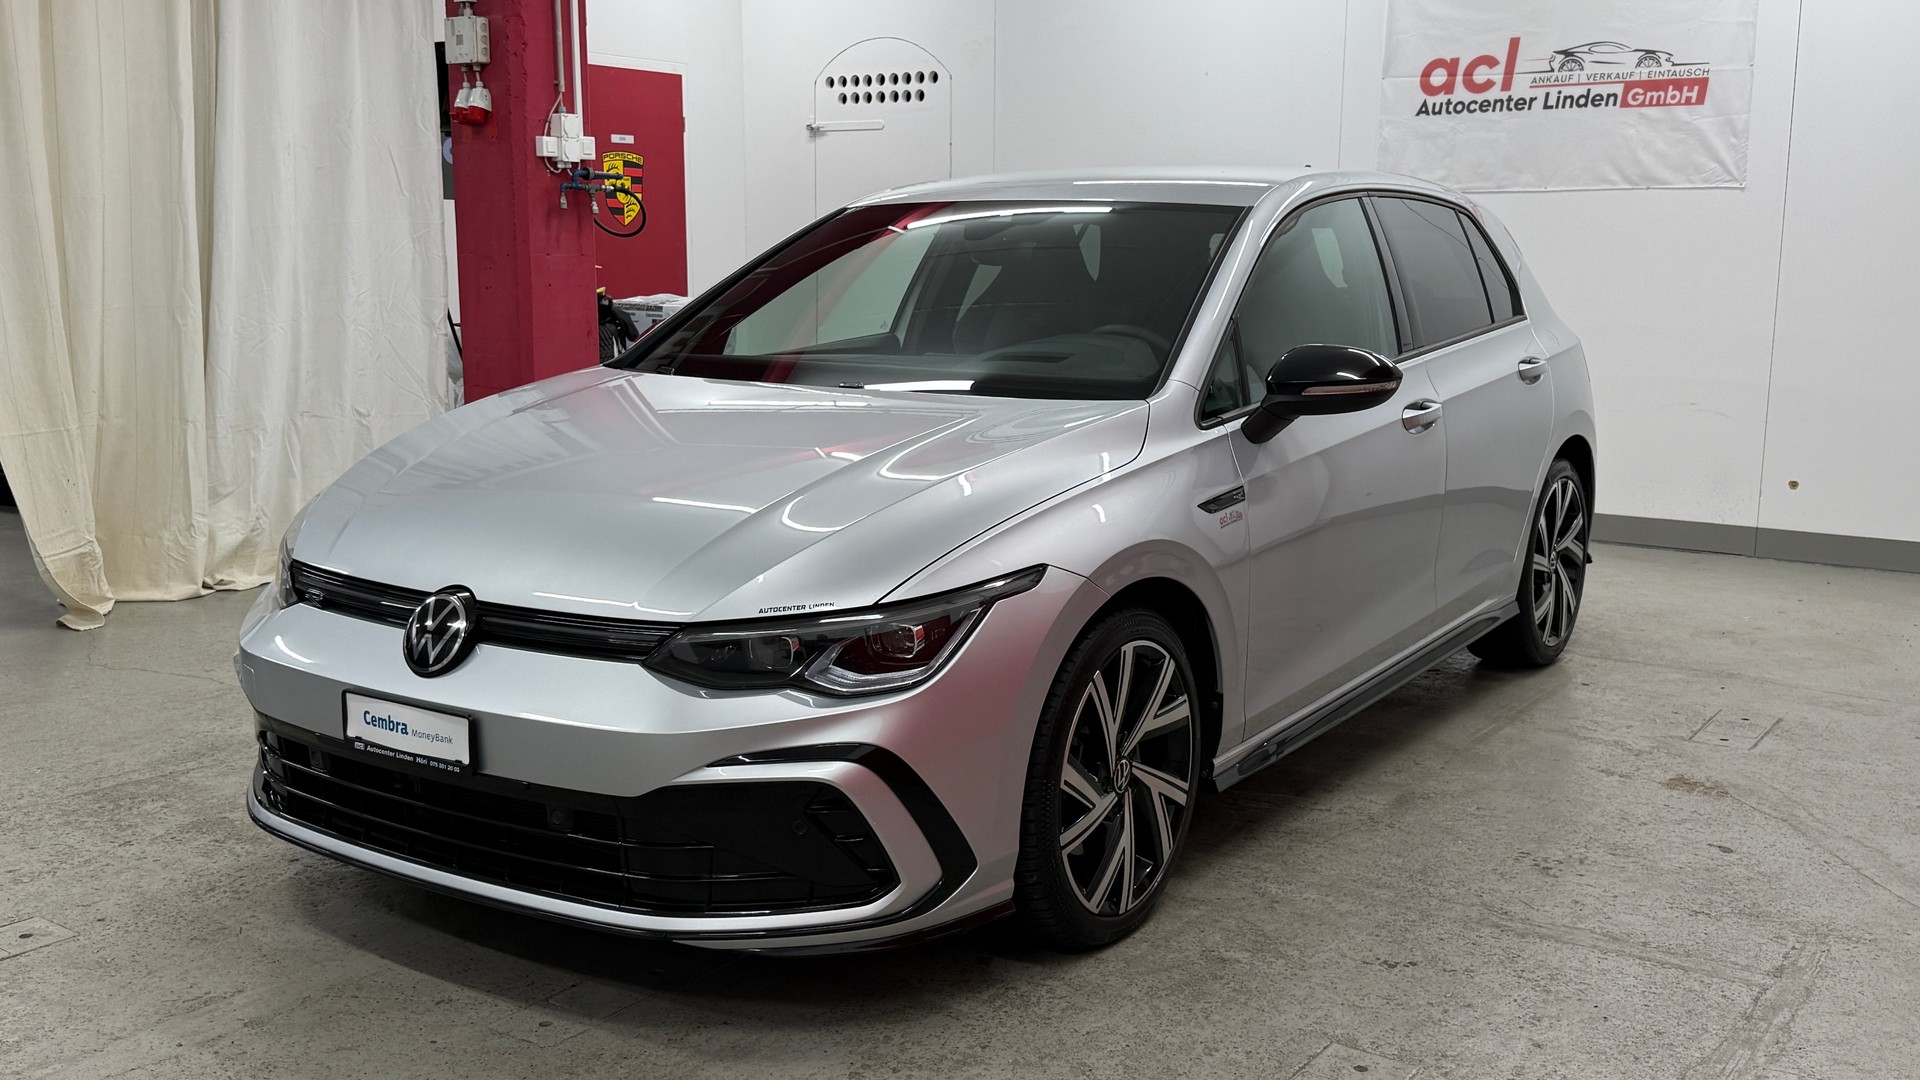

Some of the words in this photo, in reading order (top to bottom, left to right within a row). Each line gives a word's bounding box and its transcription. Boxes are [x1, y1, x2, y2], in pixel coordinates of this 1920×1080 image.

[1419, 36, 1521, 96] acl
[1530, 74, 1575, 85] ANKAUF
[1585, 71, 1635, 82] VERKAUF
[1647, 67, 1710, 79] EINTAUSCH
[1415, 95, 1538, 117] Autocenter
[1542, 87, 1618, 111] Linden
[1627, 84, 1698, 107] GmbH
[603, 153, 642, 163] PORSCHE
[758, 605, 807, 614] AUTOCENTER
[363, 710, 409, 736] Cembra
[411, 729, 453, 745] MoneyBank
[366, 745, 395, 757] Autocenter
[396, 752, 414, 761] Linden
[416, 757, 428, 765] Höri
